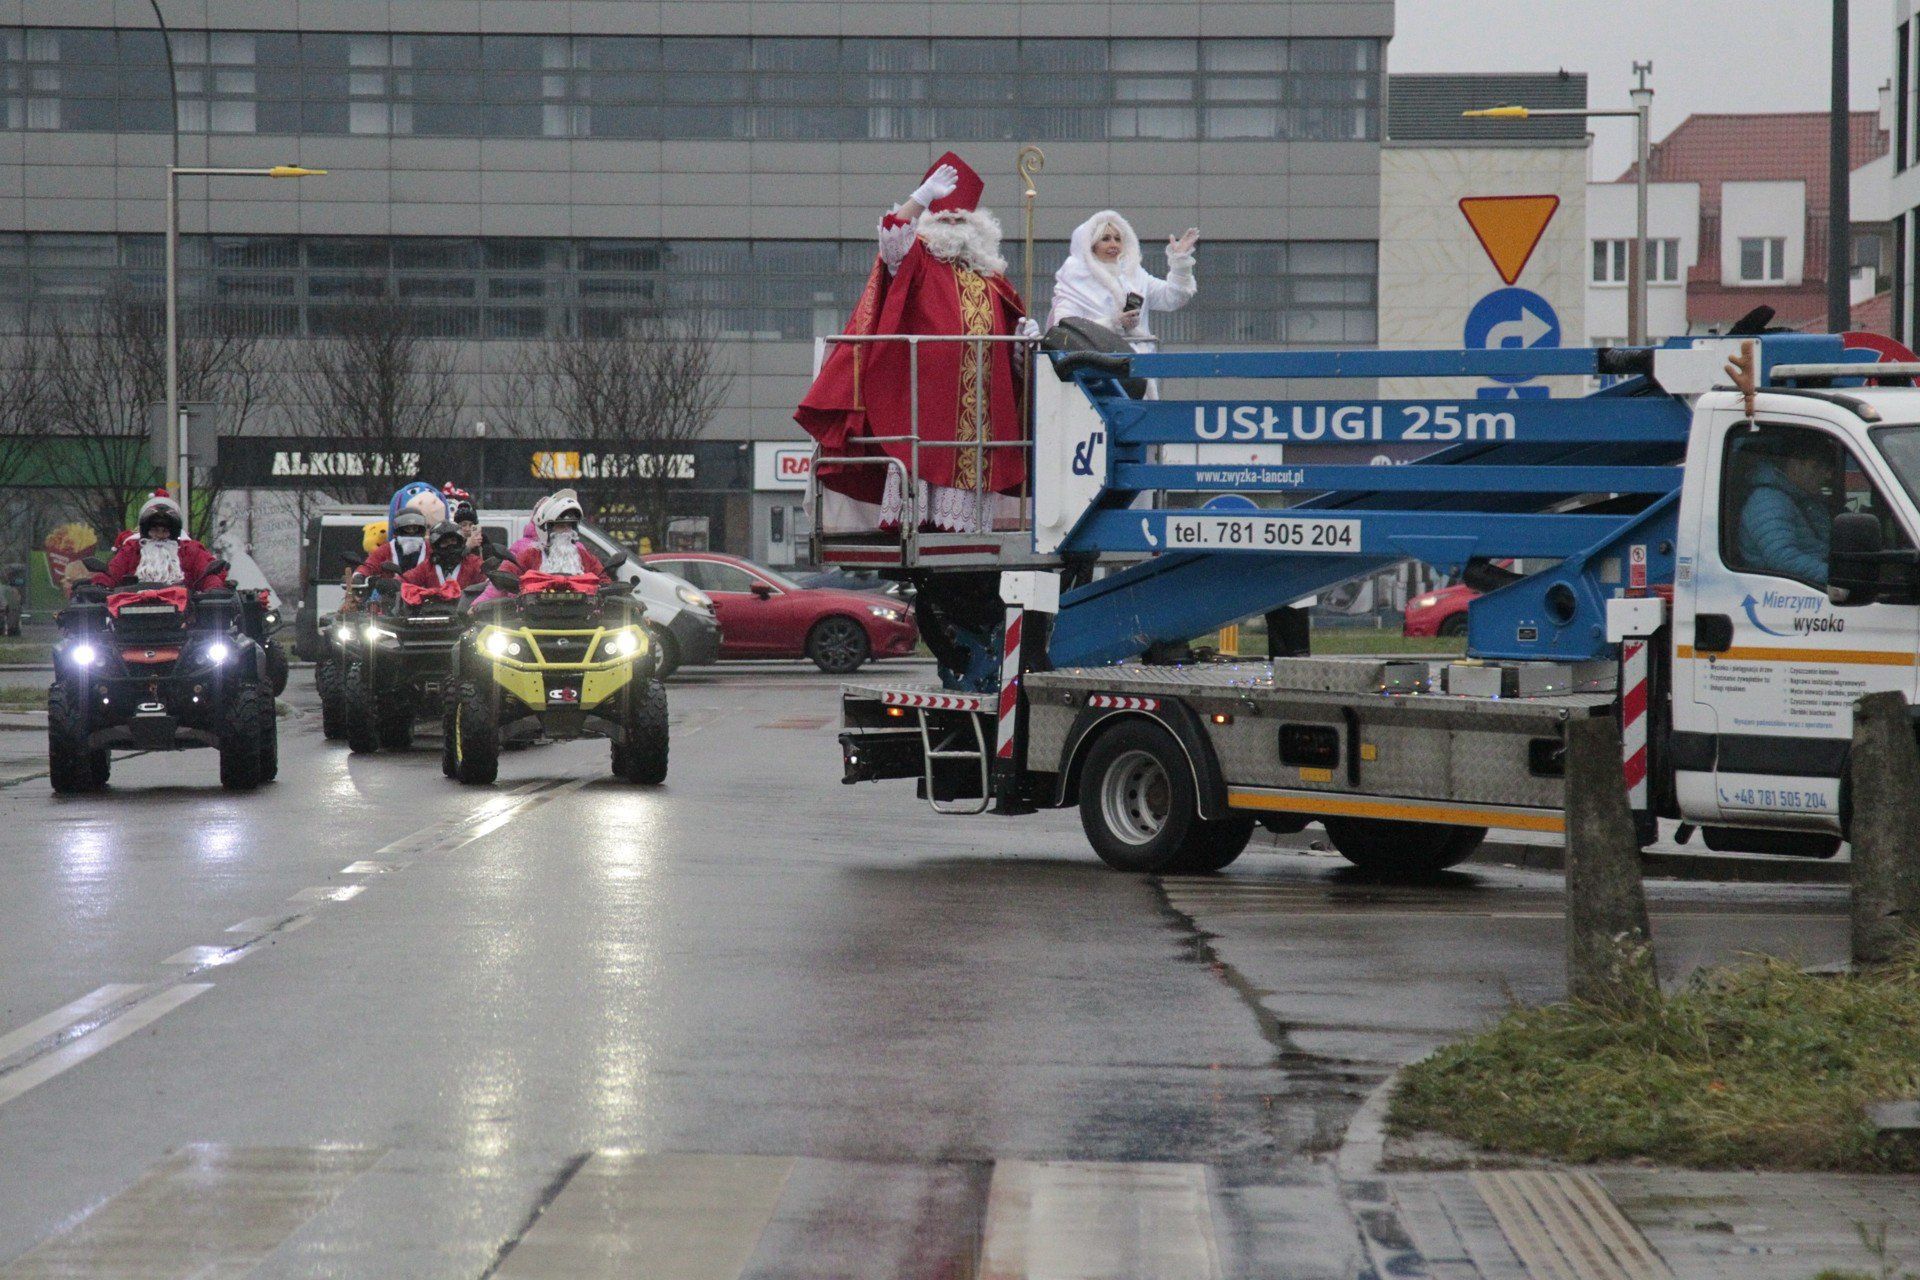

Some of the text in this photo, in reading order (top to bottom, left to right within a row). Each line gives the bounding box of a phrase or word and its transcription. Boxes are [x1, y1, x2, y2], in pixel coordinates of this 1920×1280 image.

[1194, 405, 1516, 440] USŁUGI 25m
[1196, 468, 1304, 486] www.zwyzka-lancut.pl
[1175, 522, 1352, 546] tel. 781 505 204
[1763, 591, 1824, 613] Mierzymy
[1794, 613, 1845, 636] wysoko
[1735, 789, 1827, 809] +48 781 505 204
